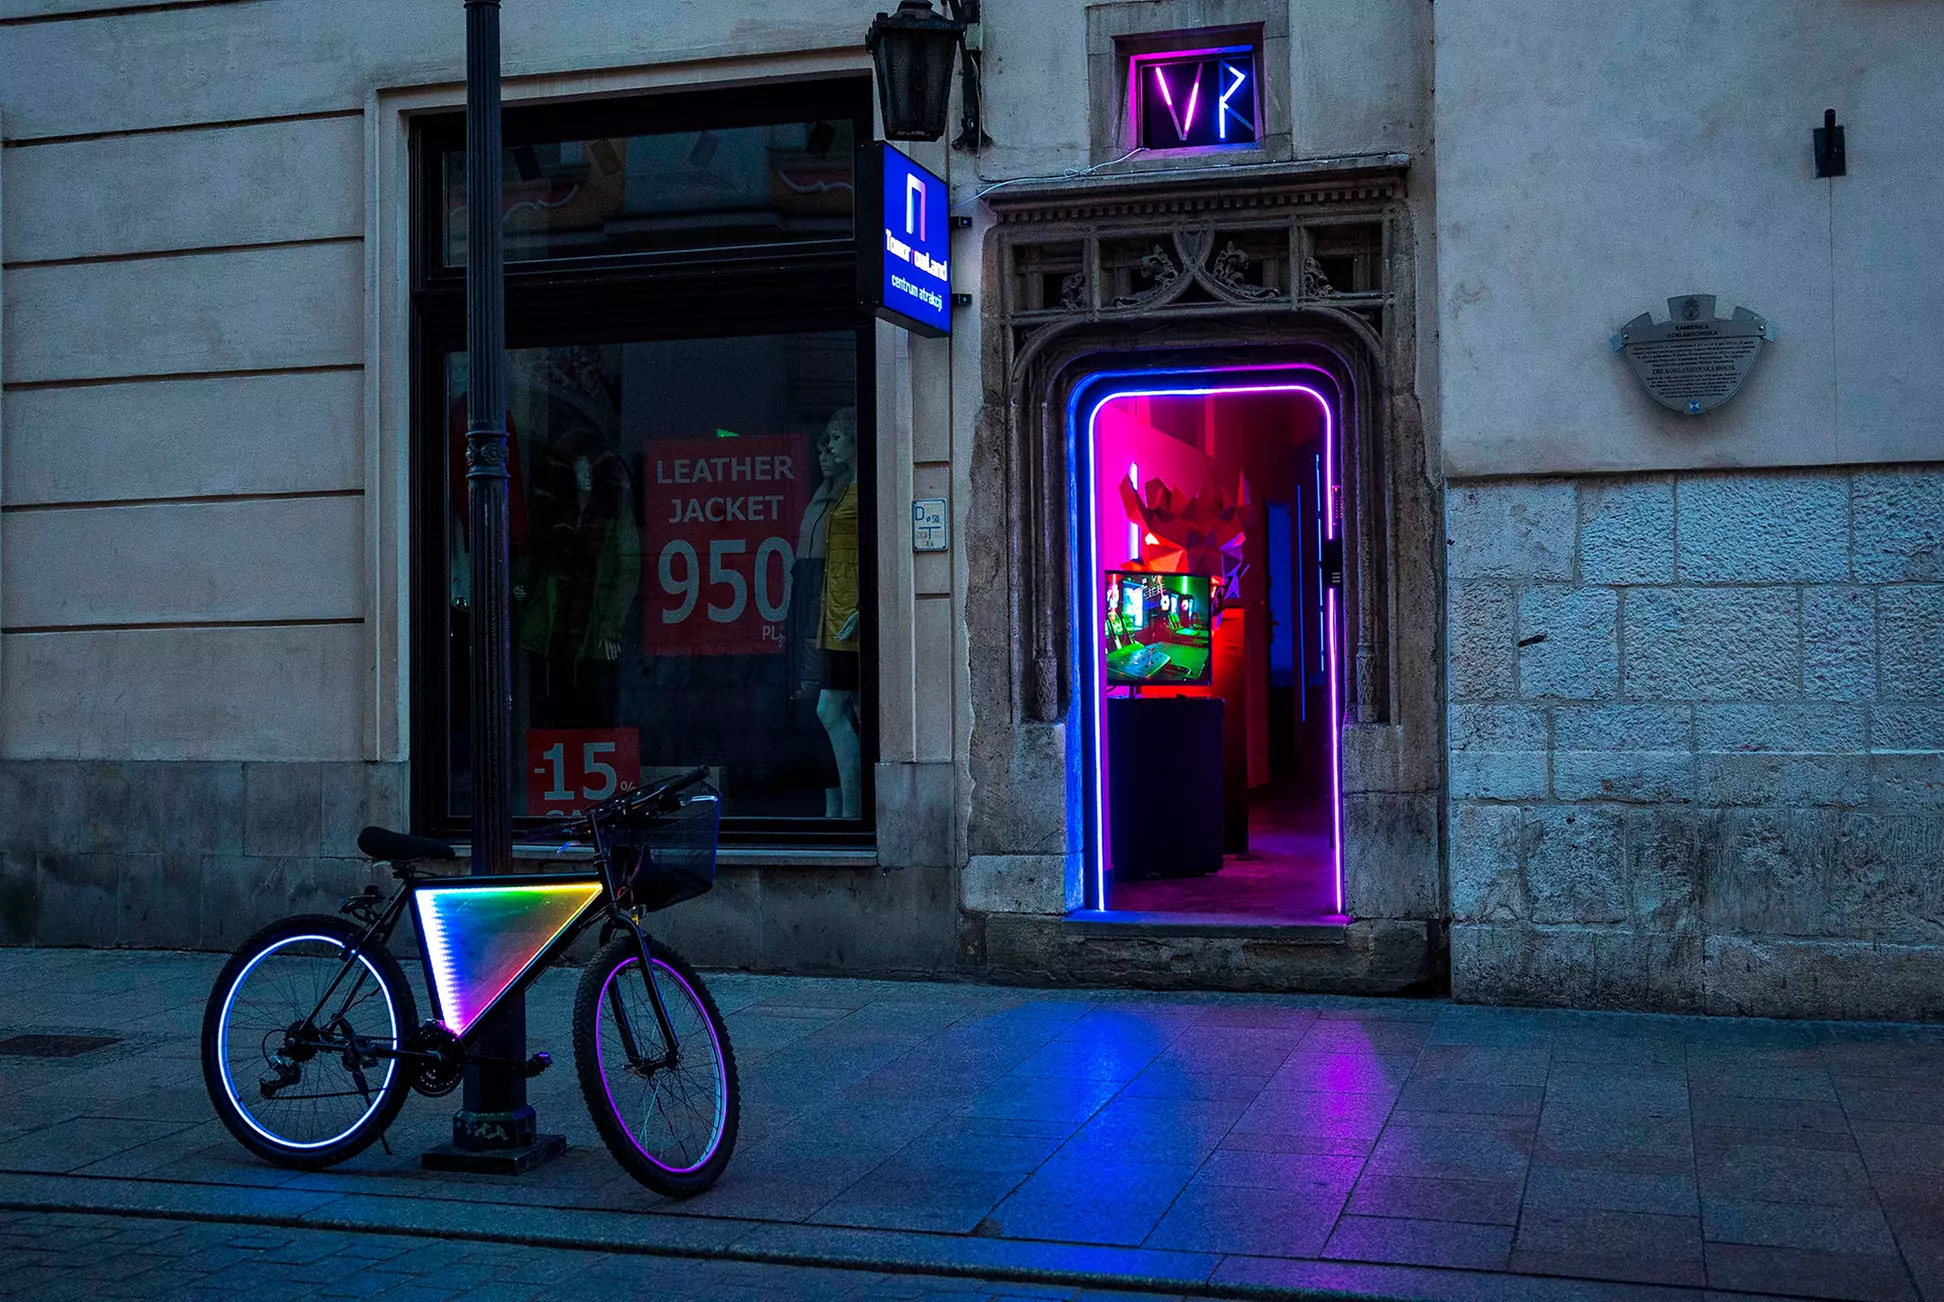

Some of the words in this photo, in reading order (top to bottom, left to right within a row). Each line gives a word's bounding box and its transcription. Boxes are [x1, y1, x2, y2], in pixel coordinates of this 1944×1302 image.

[1155, 58, 1254, 141] VR
[891, 274, 919, 298] centrum
[918, 288, 943, 313] atrakcji
[656, 455, 794, 484] LEATHER
[669, 495, 784, 523] JACKET
[915, 507, 925, 520] D
[657, 536, 795, 624] 950
